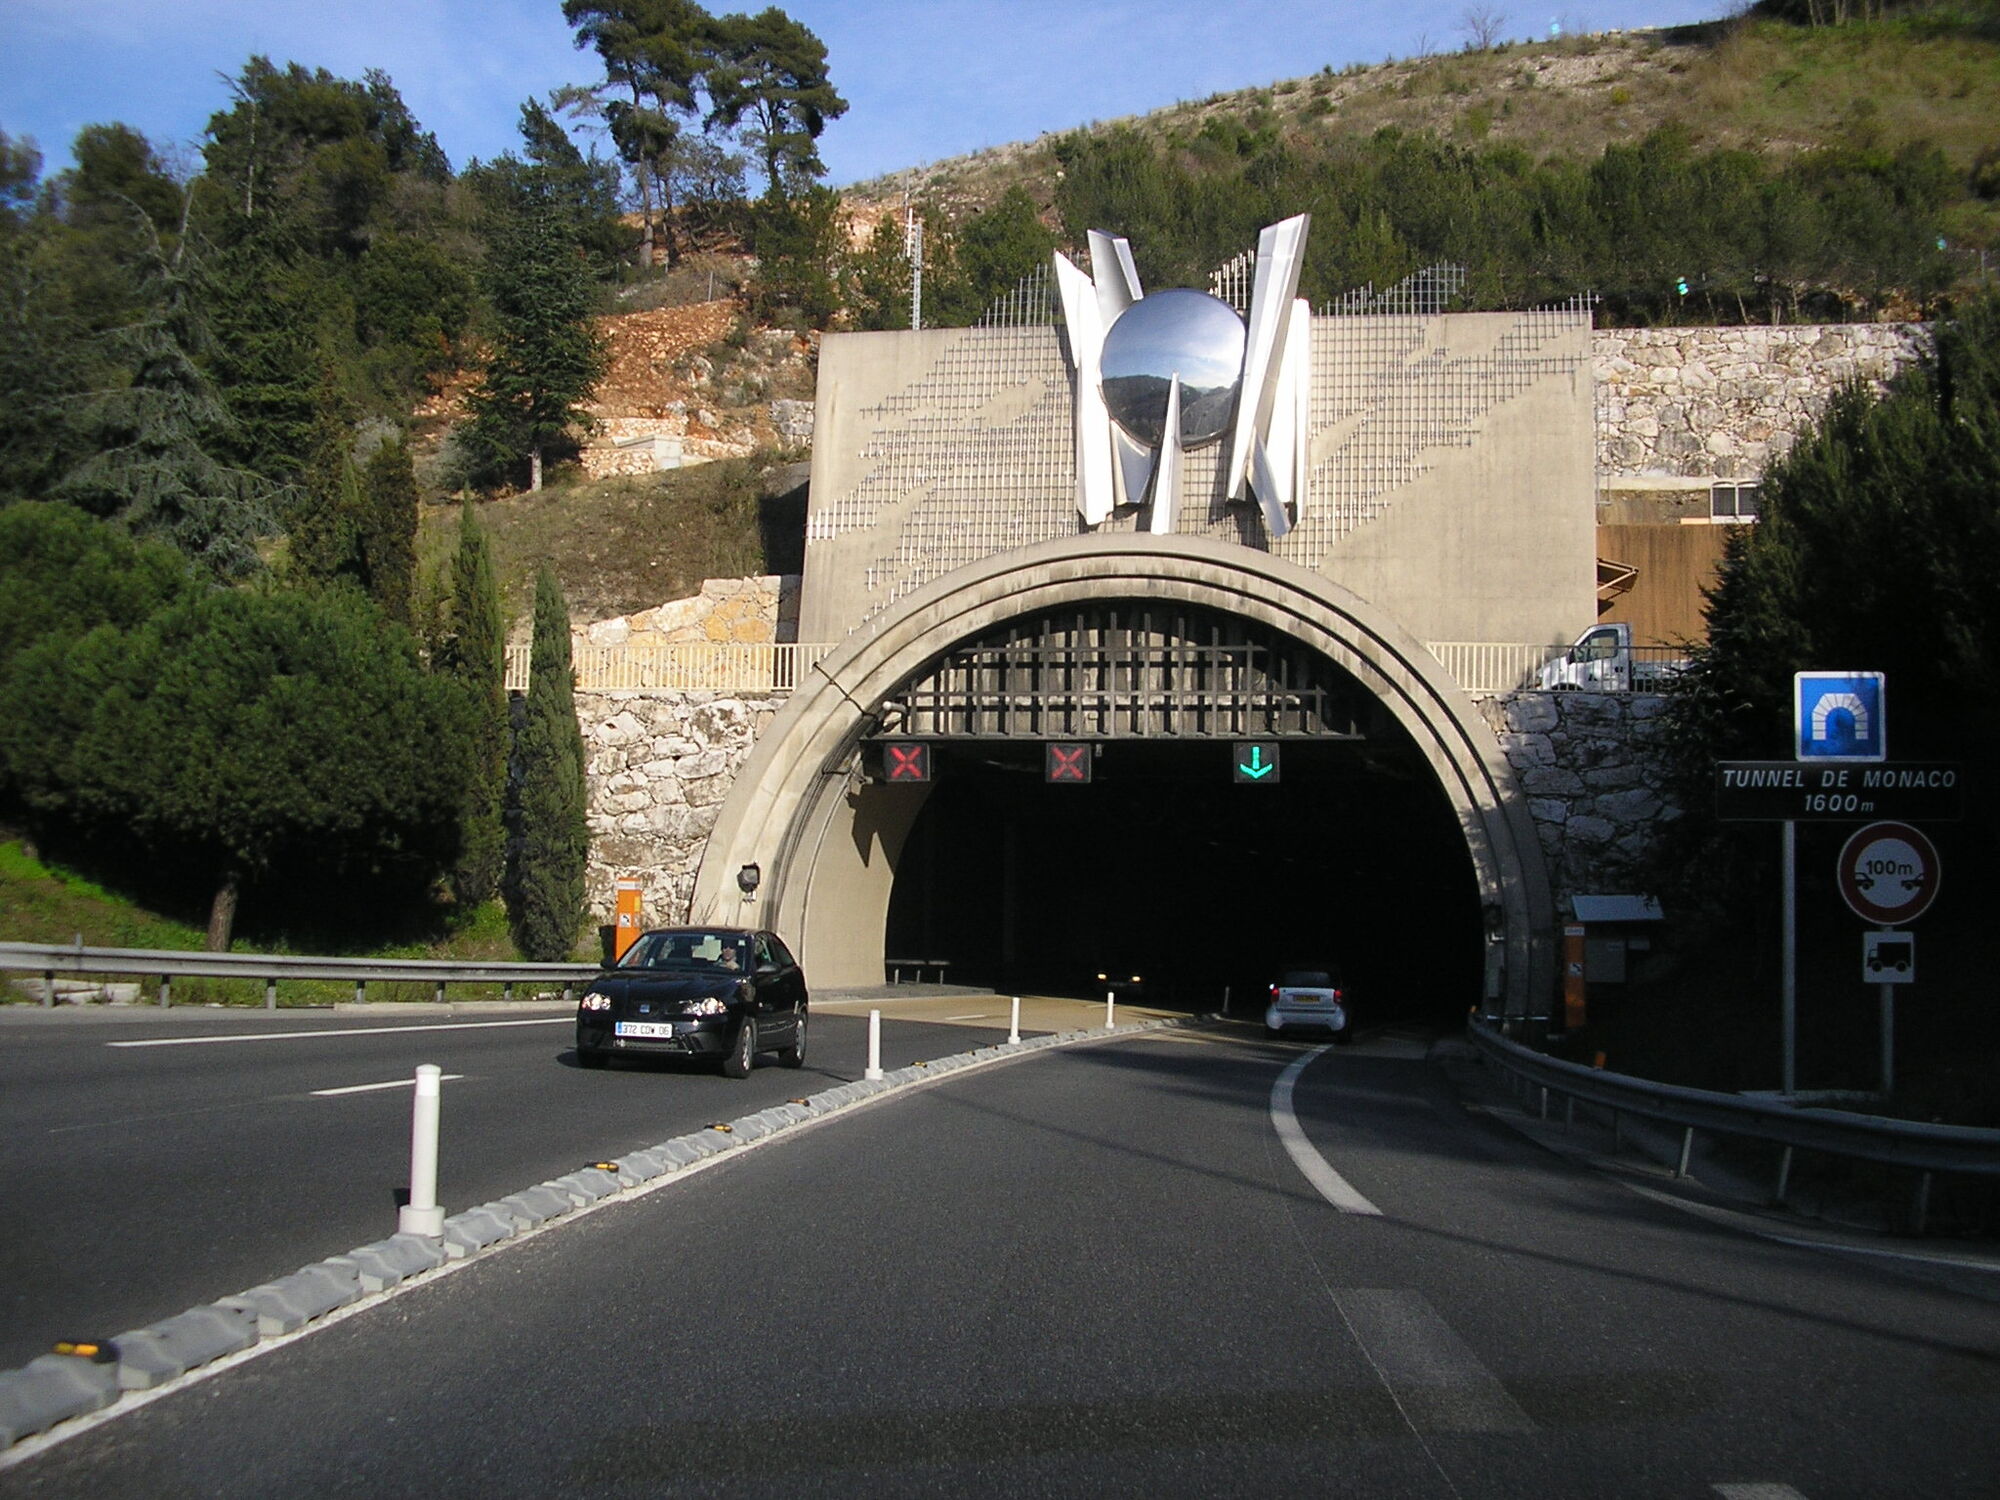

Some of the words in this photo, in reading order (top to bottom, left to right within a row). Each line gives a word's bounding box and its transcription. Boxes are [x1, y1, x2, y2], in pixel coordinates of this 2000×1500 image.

[1723, 769, 1805, 788] TUNNEL
[1821, 769, 1849, 788] DE
[1863, 770, 1956, 788] MONACO
[1866, 860, 1913, 875] 100m
[623, 1024, 637, 1034] 372
[658, 1026, 670, 1035] 06
